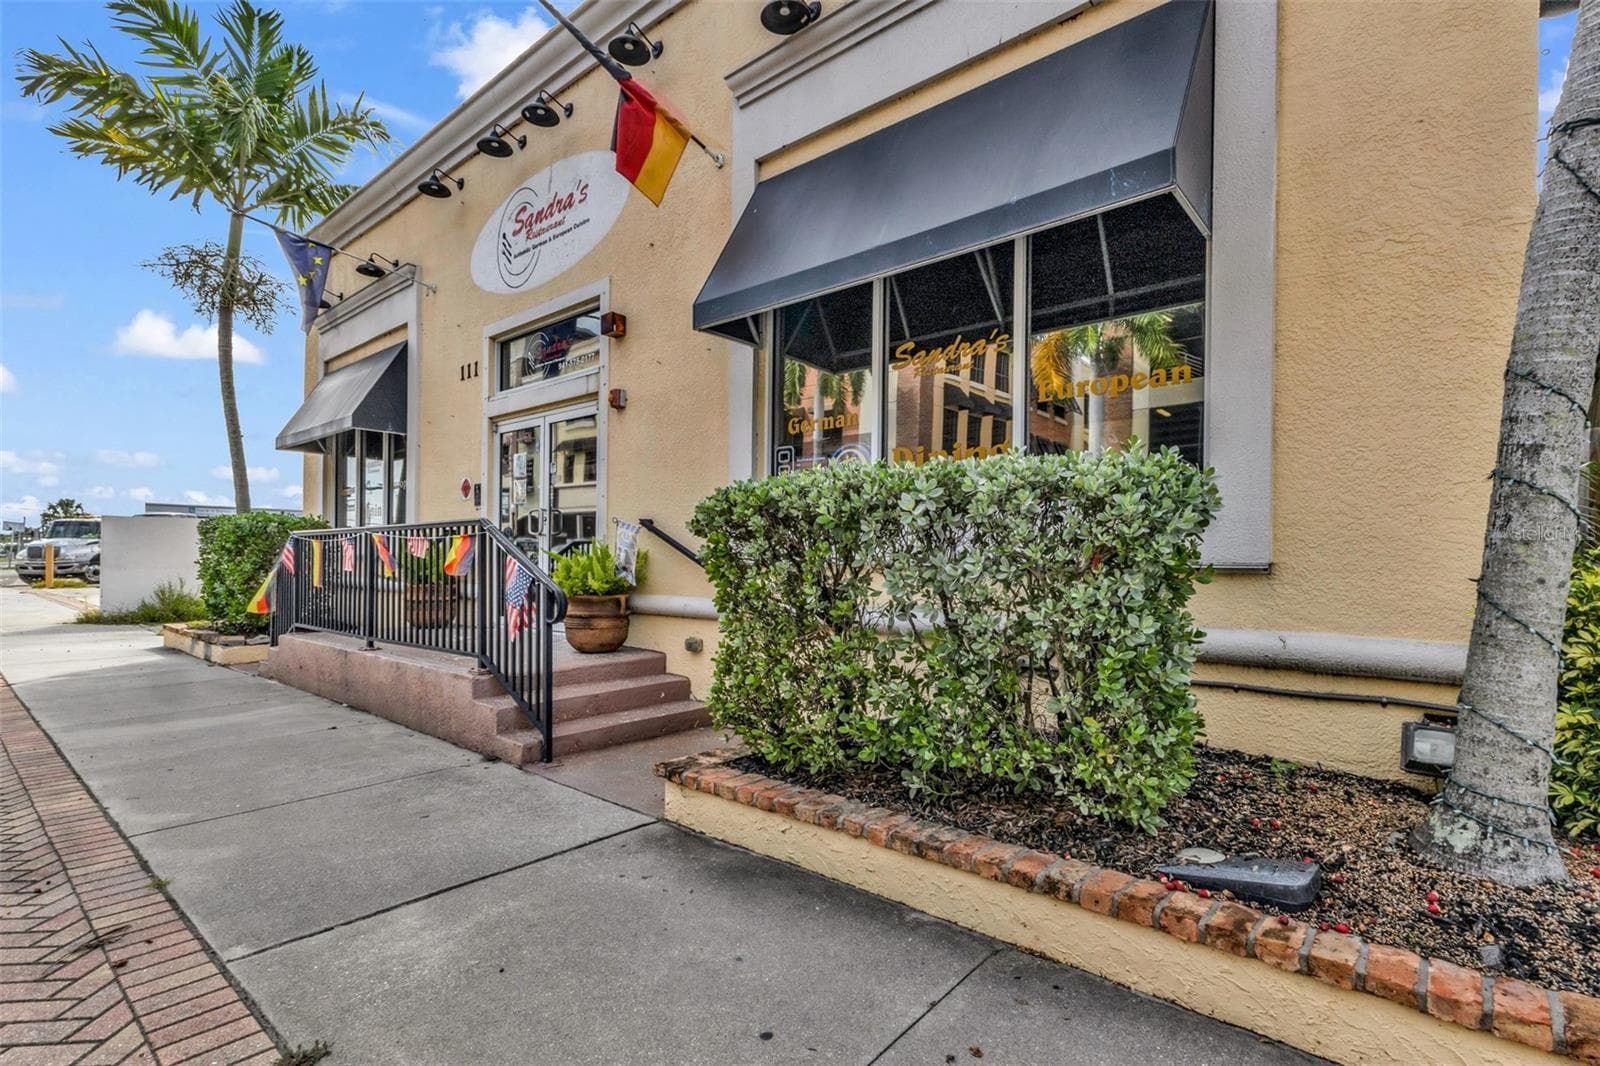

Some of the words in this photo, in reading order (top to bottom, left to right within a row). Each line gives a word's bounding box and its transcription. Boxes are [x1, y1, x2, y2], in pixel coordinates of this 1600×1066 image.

[512, 179, 589, 237] Sandra's
[891, 328, 1010, 370] Sandra's
[460, 360, 479, 381] 111
[1037, 363, 1193, 402] European
[787, 412, 859, 435] German
